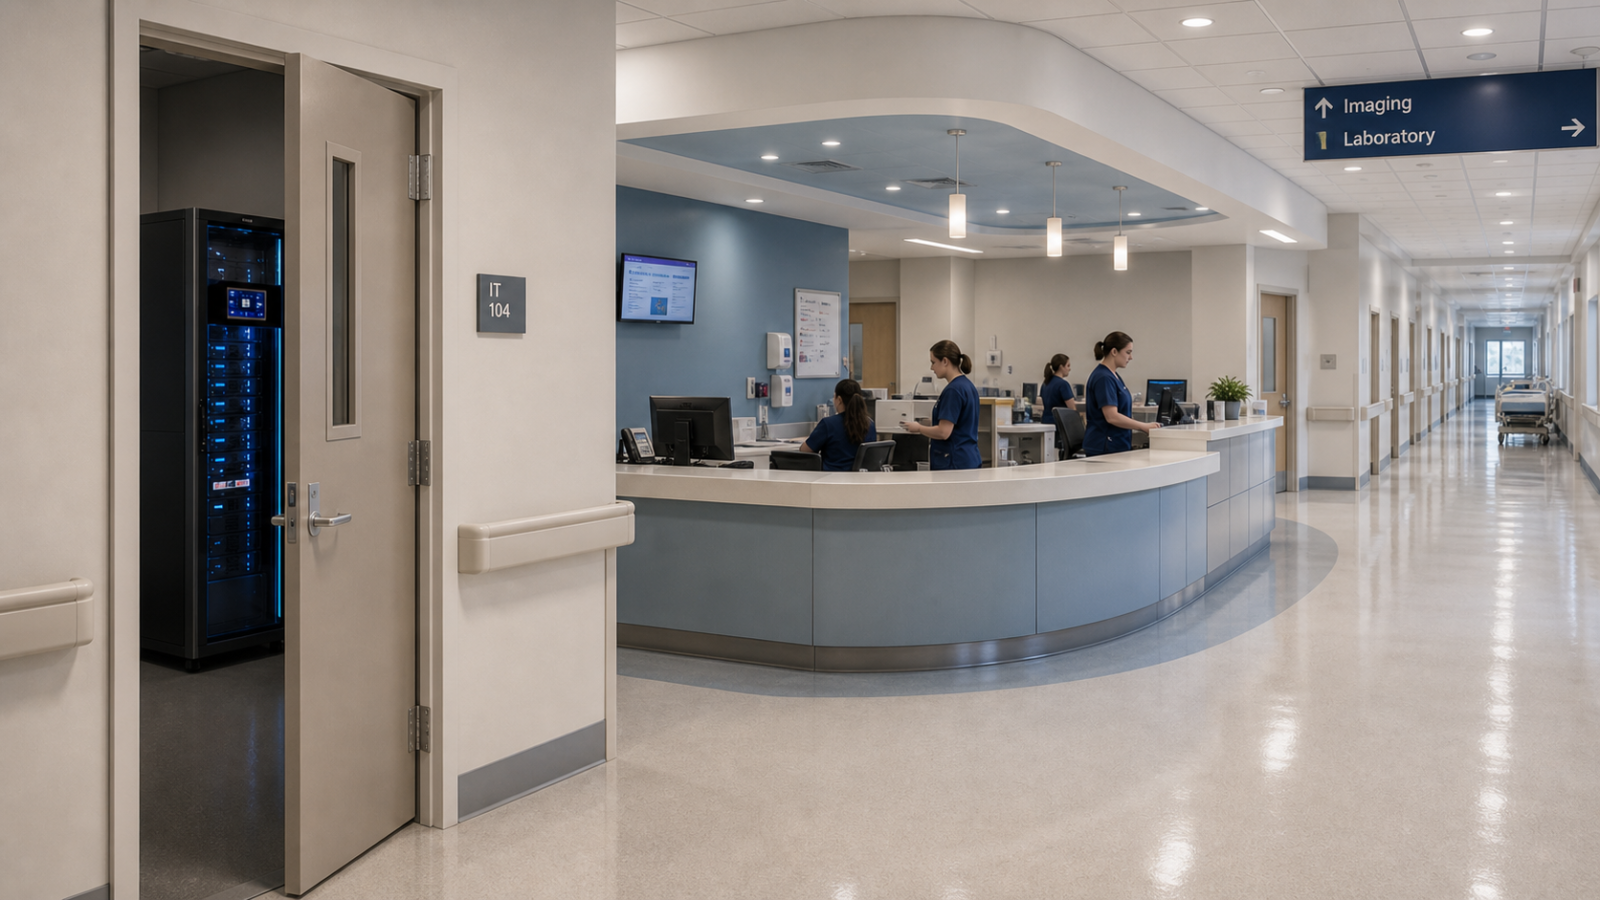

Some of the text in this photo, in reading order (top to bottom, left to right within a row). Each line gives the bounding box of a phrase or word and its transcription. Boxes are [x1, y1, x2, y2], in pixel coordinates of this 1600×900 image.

[1344, 95, 1412, 115] Imaging
[1344, 129, 1436, 146] Laboratory
[489, 281, 502, 298] IT
[488, 302, 511, 318] 104
